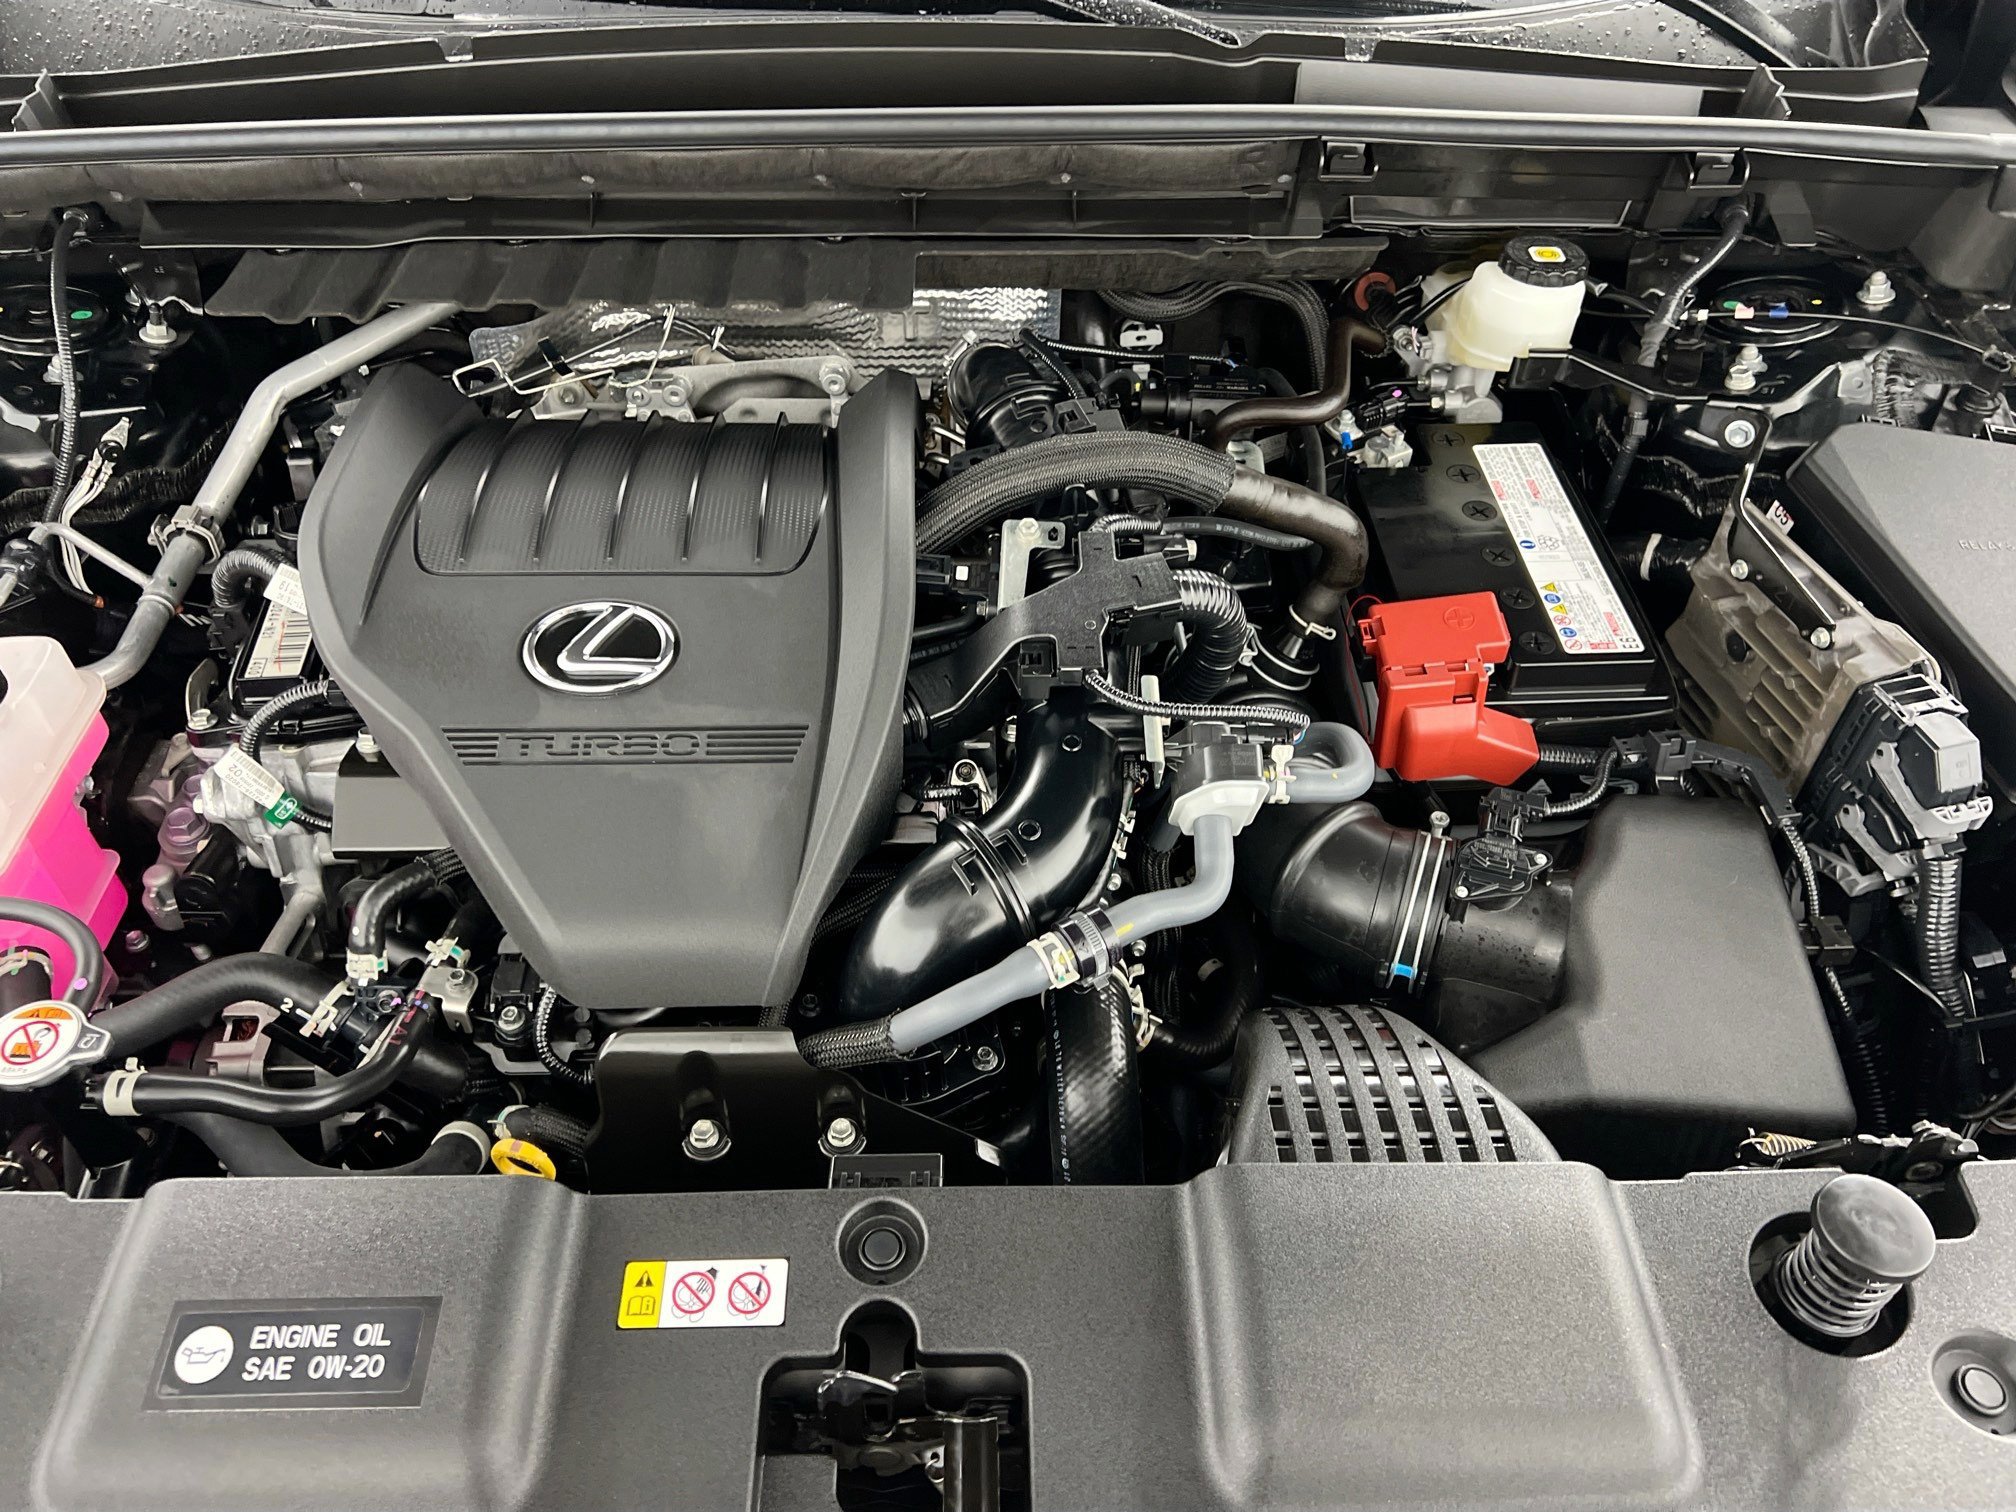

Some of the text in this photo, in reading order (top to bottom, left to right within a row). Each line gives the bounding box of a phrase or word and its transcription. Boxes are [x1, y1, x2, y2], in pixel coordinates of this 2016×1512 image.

[506, 732, 699, 757] TURBO
[281, 998, 294, 1013] 2
[250, 1322, 391, 1349] ENGINE OIL
[241, 1354, 386, 1382] SAE 0W-20
